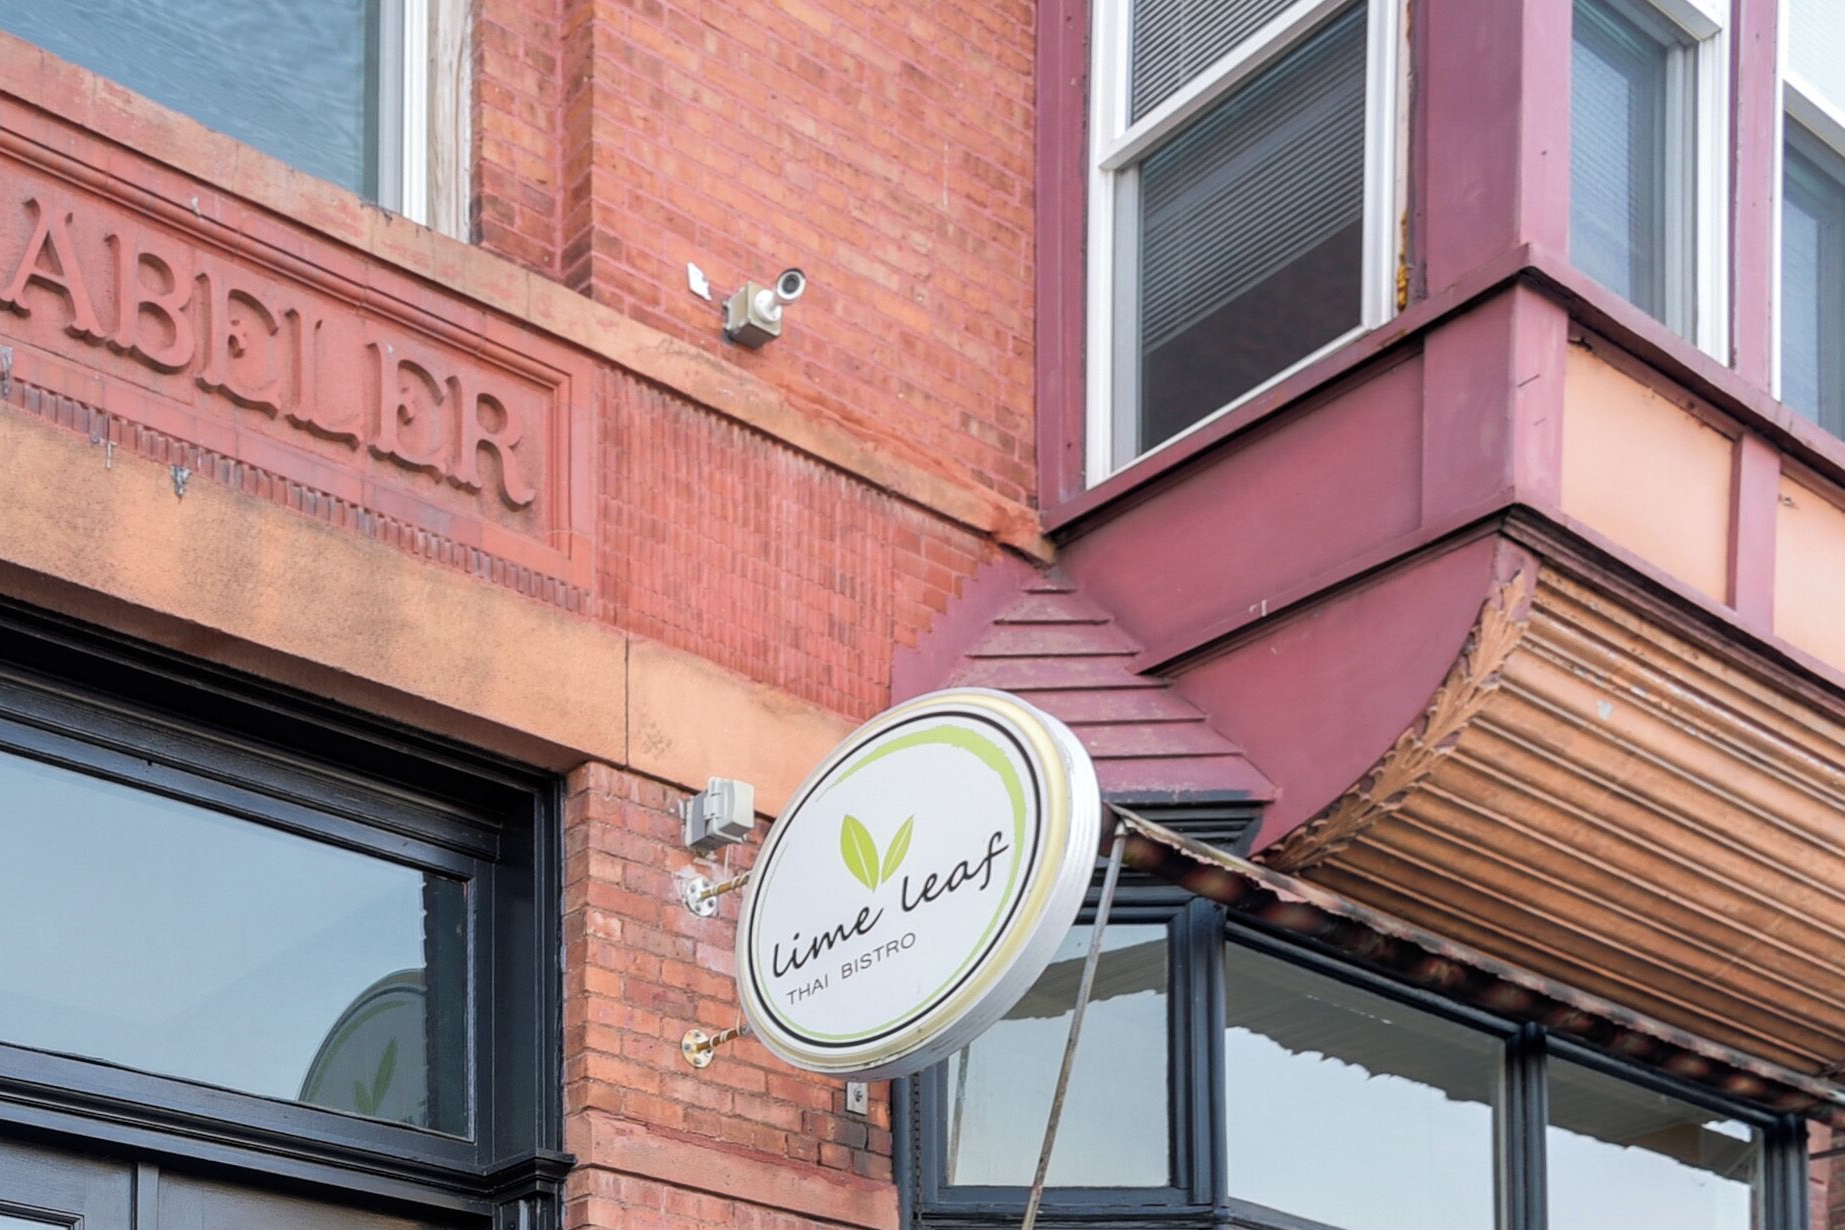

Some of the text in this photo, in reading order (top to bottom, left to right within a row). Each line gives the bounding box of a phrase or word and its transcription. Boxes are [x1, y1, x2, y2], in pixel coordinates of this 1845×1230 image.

[772, 831, 1010, 978] lime leaf
[786, 932, 916, 1005] THAI BISTRO
